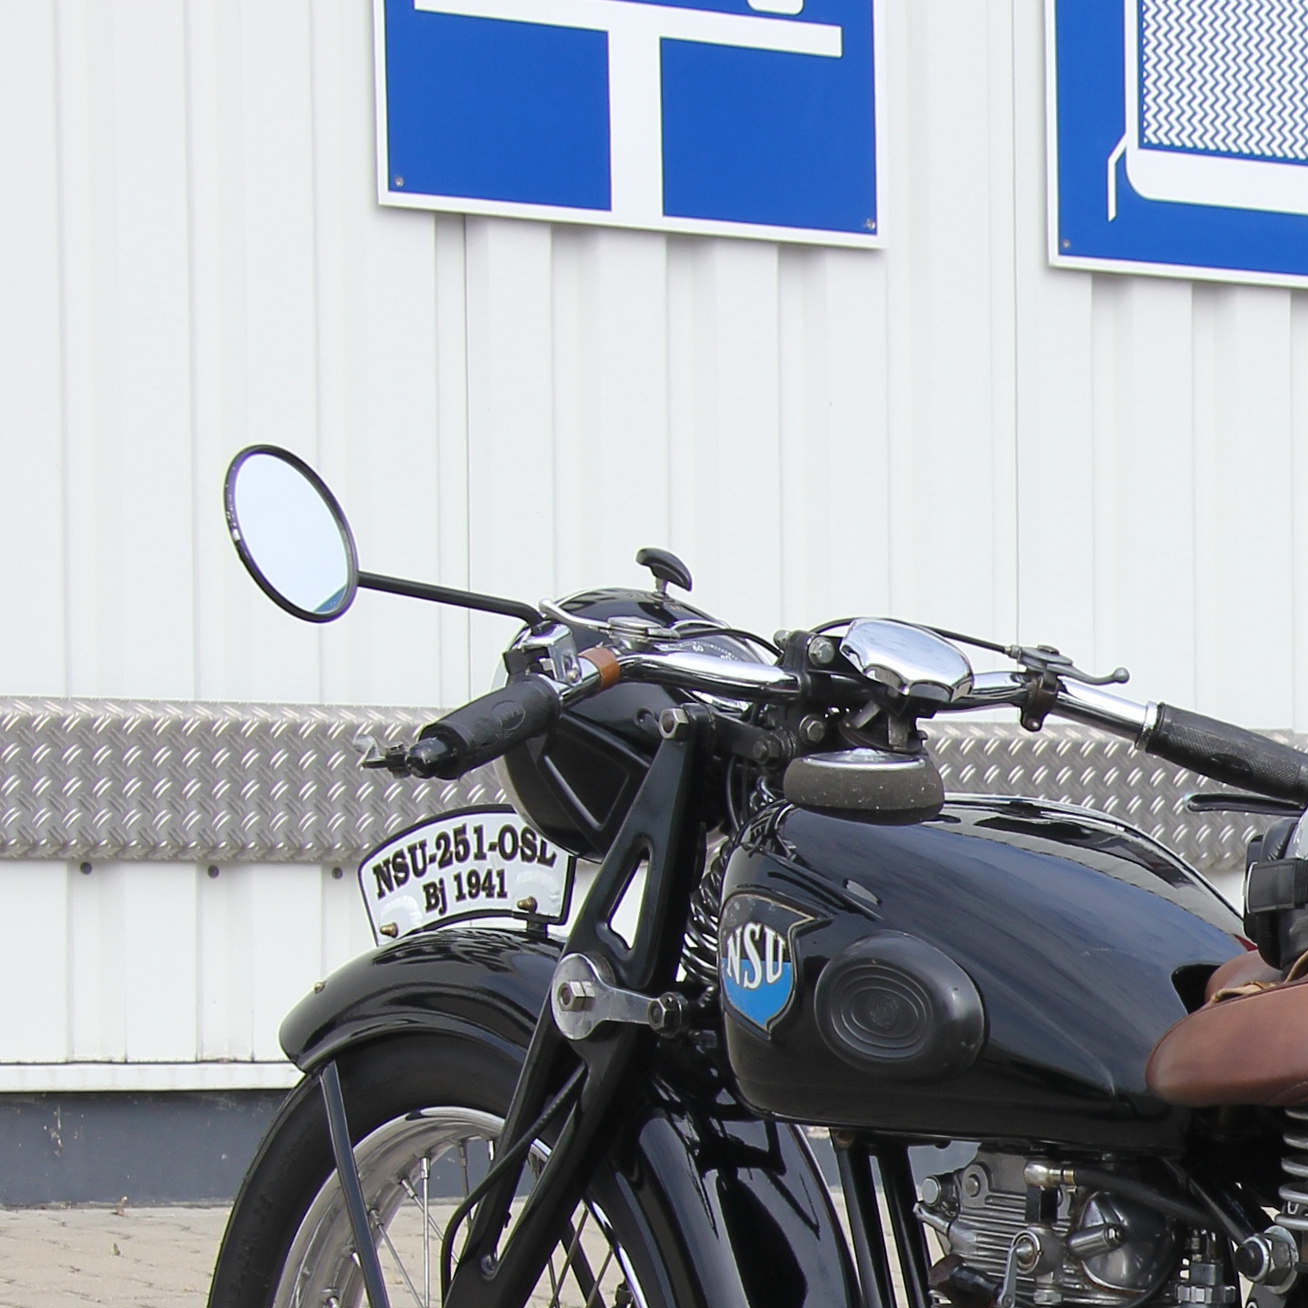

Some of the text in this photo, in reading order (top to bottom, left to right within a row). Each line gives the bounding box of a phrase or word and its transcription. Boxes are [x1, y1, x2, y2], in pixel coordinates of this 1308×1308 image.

[372, 824, 557, 900] NSU-251-OSL
[423, 868, 508, 915] Bj 1941
[727, 921, 786, 989] NSU
